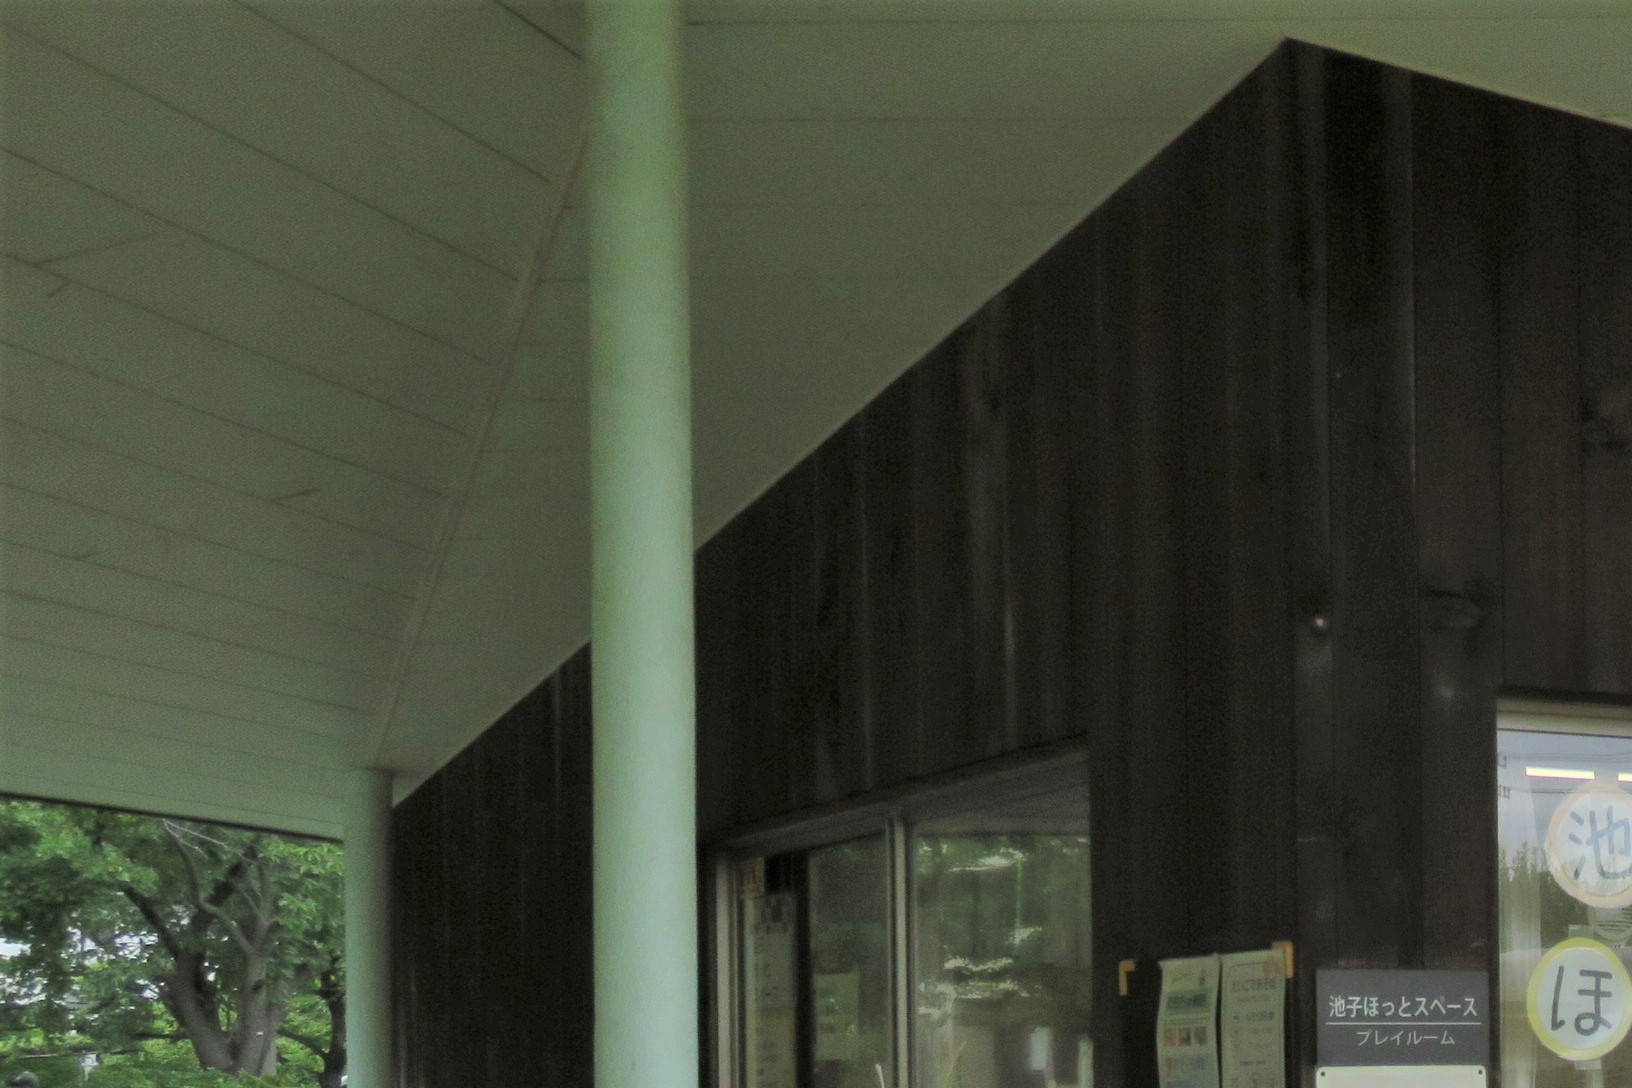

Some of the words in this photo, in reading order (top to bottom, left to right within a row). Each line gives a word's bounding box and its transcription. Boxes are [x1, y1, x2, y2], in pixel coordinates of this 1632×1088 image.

[1328, 996, 1478, 1018] 池子ほっとスペース
[1356, 1030, 1456, 1047] プレイルーム
